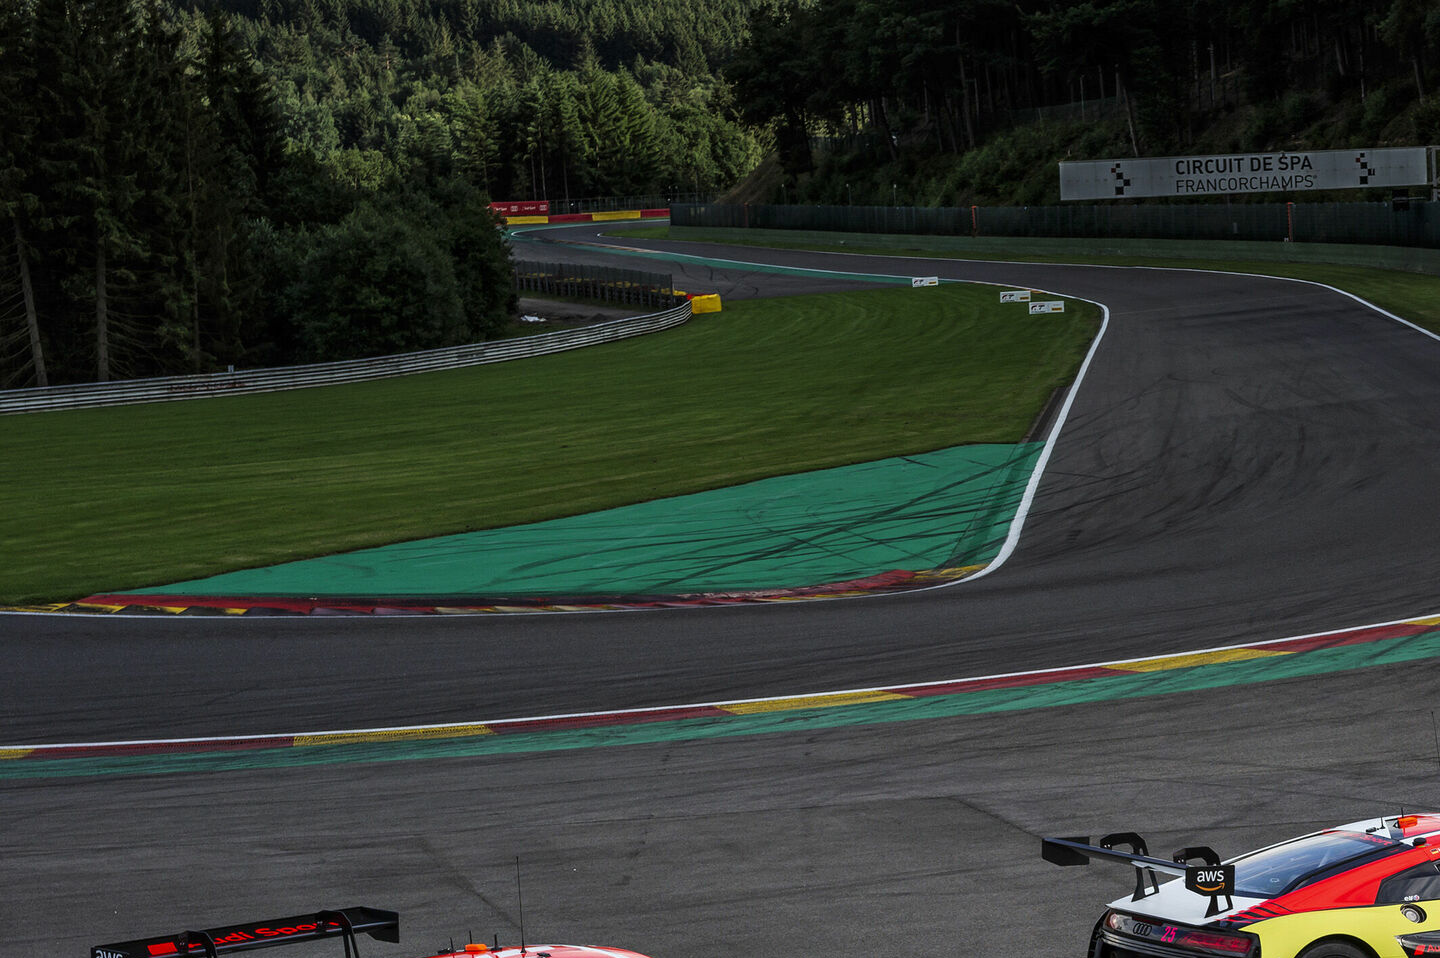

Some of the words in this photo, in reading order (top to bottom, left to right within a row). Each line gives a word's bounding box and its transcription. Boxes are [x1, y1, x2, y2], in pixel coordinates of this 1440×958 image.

[1176, 158, 1244, 175] CIRCUIT
[1250, 156, 1273, 172] DE
[1278, 155, 1313, 171] SPA
[1176, 175, 1315, 193] FRANCORCHAMPS
[1197, 870, 1225, 882] aws
[1161, 925, 1178, 943] 25
